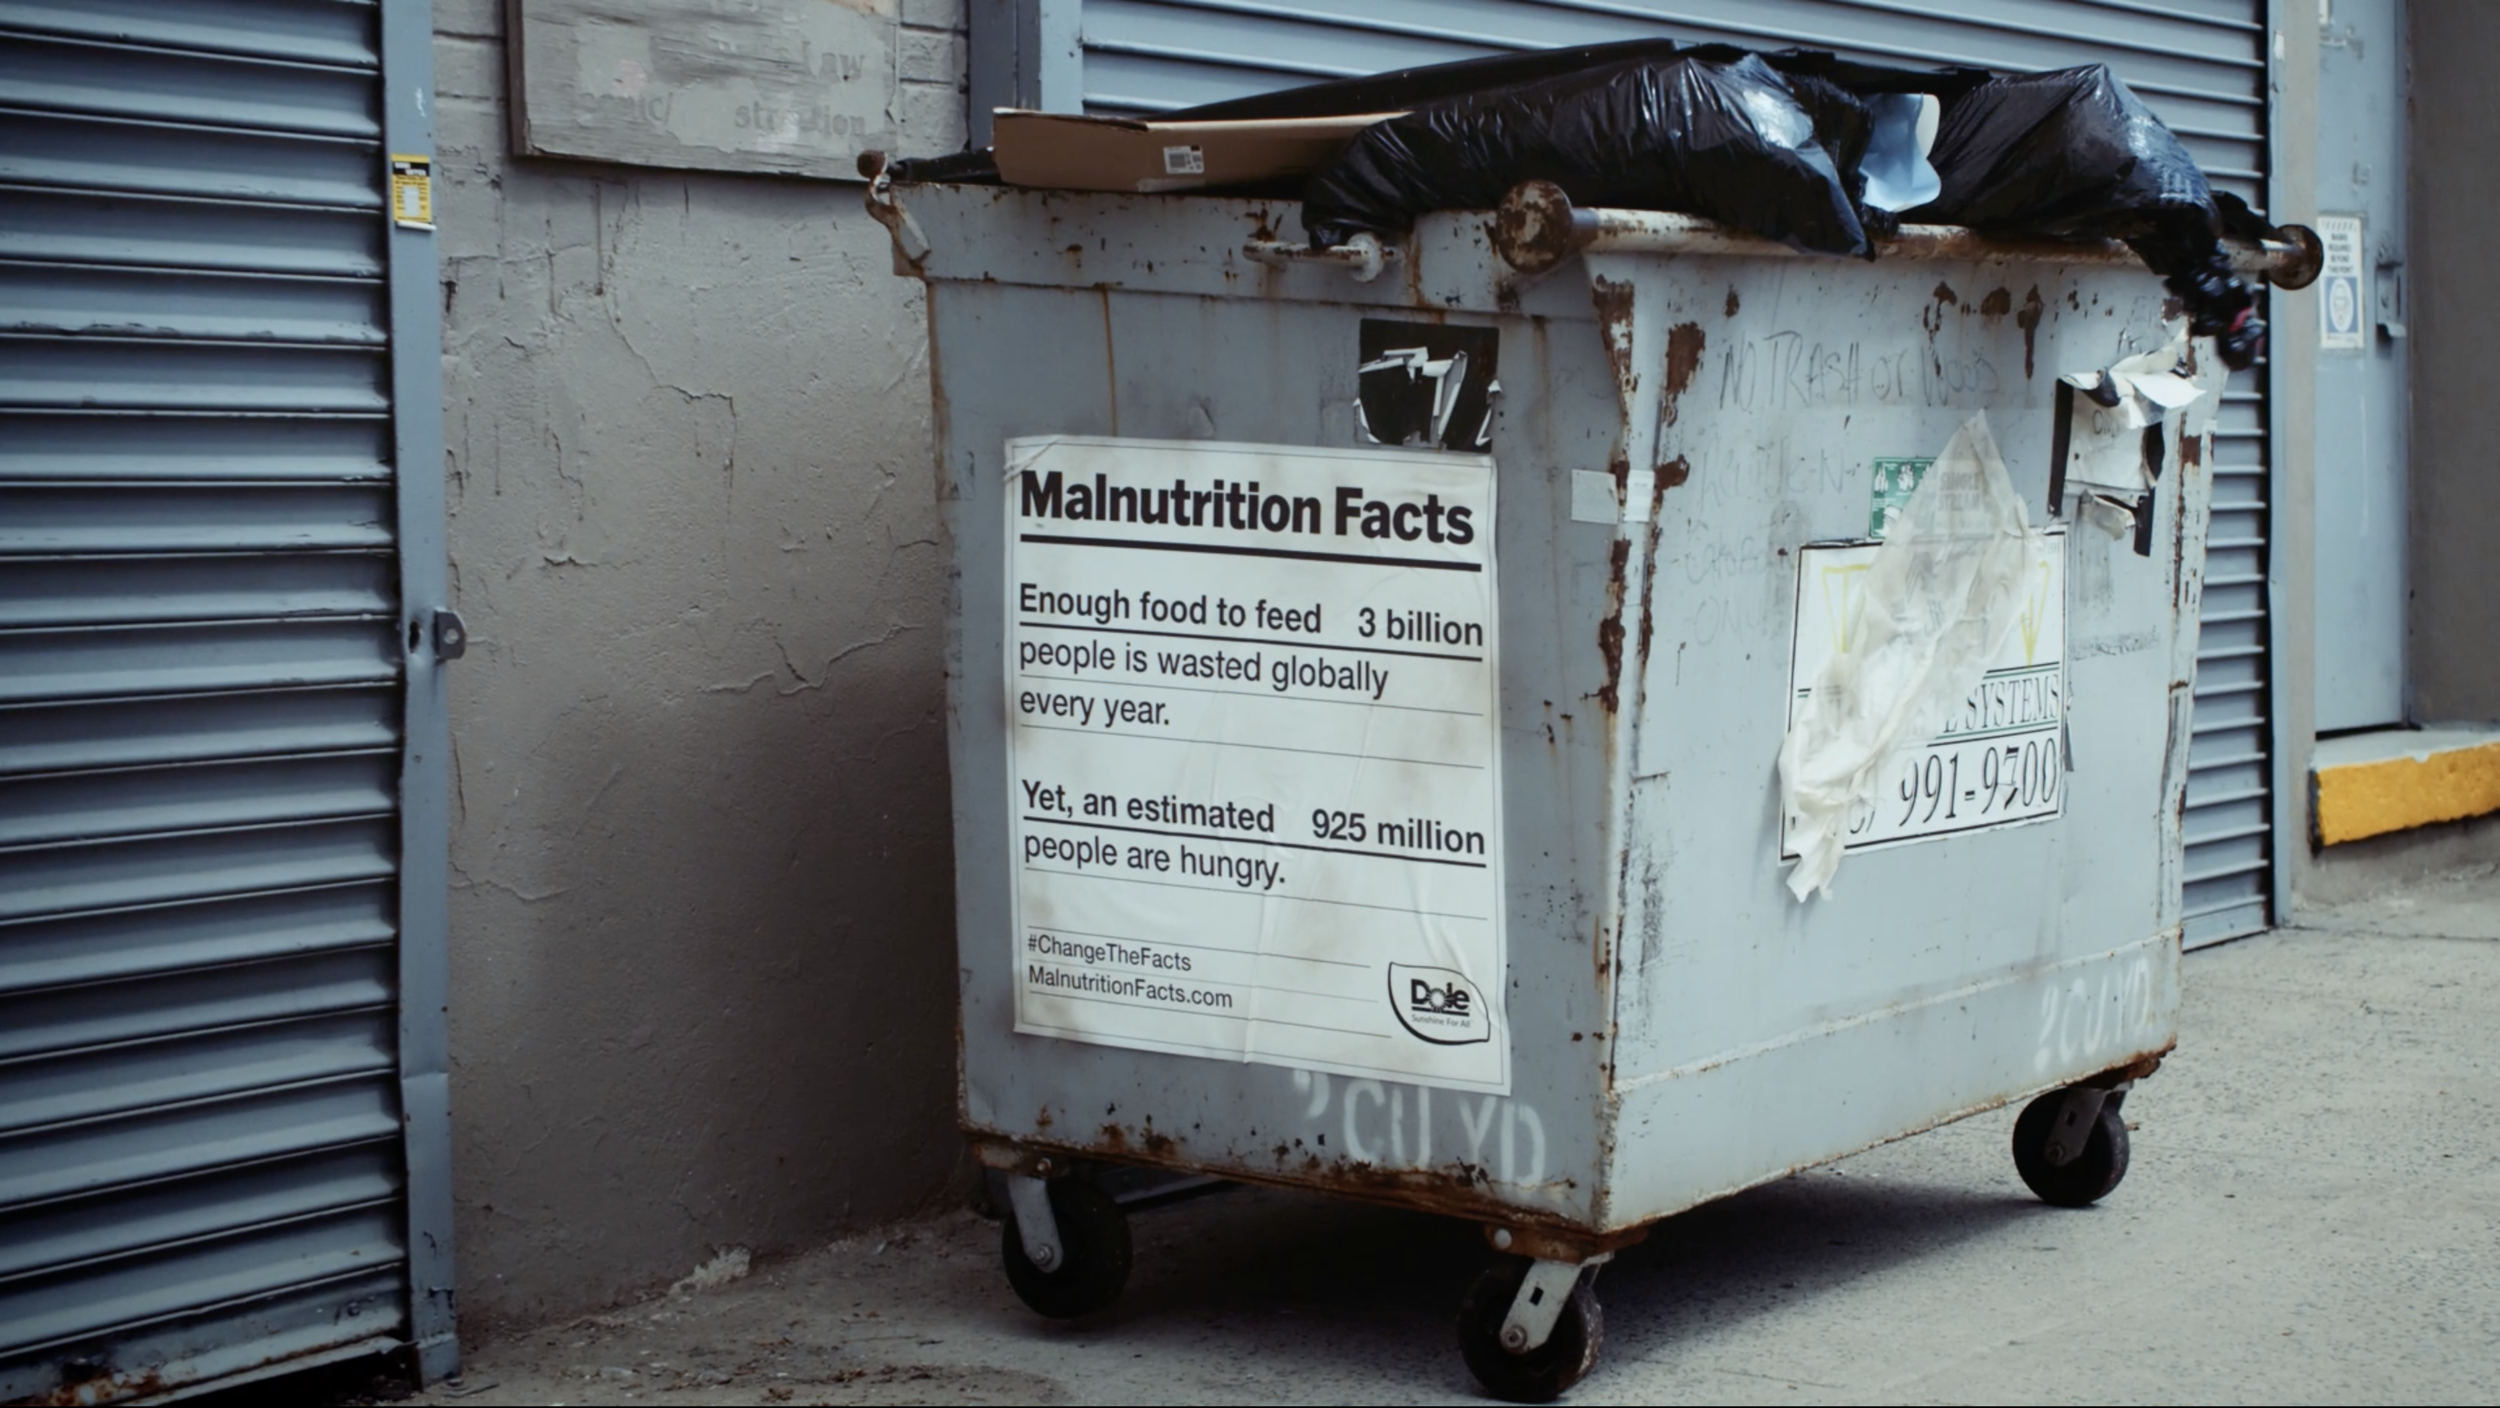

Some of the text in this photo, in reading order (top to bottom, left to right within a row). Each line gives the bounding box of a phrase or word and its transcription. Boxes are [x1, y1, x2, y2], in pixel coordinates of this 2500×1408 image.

[1020, 469, 1475, 545] Malnutrition Facts
[1020, 582, 1483, 647] Enough food to feed 3 billion
[1020, 639, 1389, 701] people is wasted globally
[1019, 690, 1170, 729] every year.
[1964, 673, 2059, 731] SYSTEMS
[1898, 737, 2058, 828] 991-9700
[1021, 779, 1486, 855] Yet, an estimated 925 million
[1024, 832, 1287, 891] people are hungry.
[1027, 933, 1192, 972] #ChangeTheFacts
[1028, 965, 1233, 1009] MalnutritionFacts.com
[1410, 978, 1471, 1013] Dole
[1411, 1013, 1445, 1026] Sunshine
[1446, 1018, 1459, 1026] For
